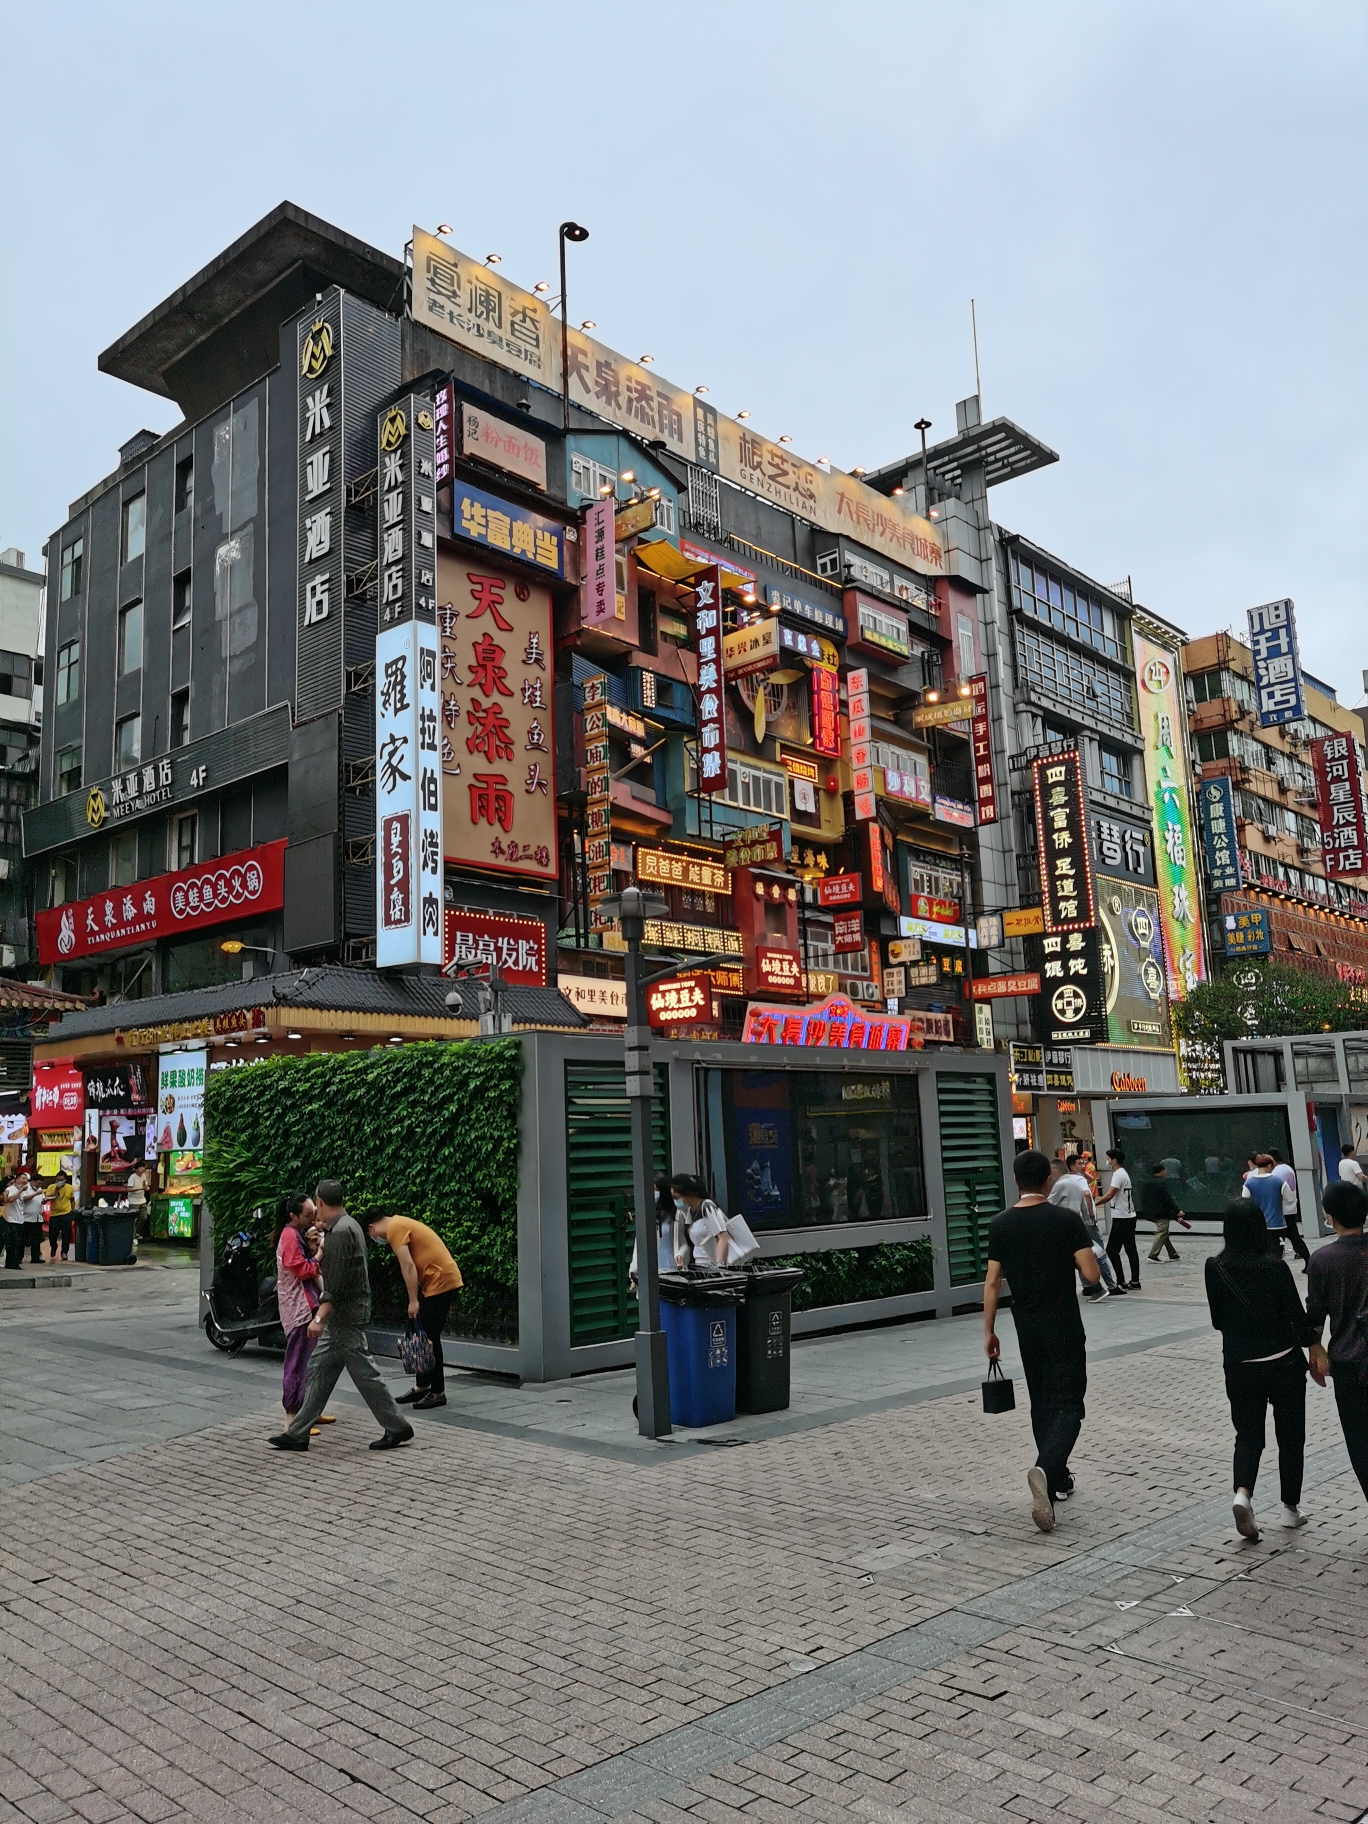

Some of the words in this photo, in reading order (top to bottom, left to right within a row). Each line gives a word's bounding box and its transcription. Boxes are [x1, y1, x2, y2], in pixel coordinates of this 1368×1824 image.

[426, 251, 540, 346] 宴澜香
[427, 297, 541, 370] 老长沙臭豆腐
[560, 342, 683, 444] 天泉添雨
[466, 414, 479, 441] 杨记
[481, 423, 543, 468] 粉面饭
[304, 383, 332, 627] 米亚酒店
[740, 469, 816, 517] GENZHILIAN
[382, 449, 402, 606] 米亚酒店
[419, 459, 433, 586] 米亚酒店
[461, 498, 558, 561] 华富典当
[594, 508, 605, 617] 汇源糕点专卖
[383, 601, 402, 622] 4F
[419, 596, 434, 610] 4F
[726, 632, 773, 659] 华兴冰室
[1252, 601, 1297, 716] 旭升酒店
[696, 580, 721, 779] 文和里美食市集
[466, 572, 515, 833] 天泉添雨
[523, 631, 548, 796] 美蛙鱼头
[972, 681, 995, 820] 鸿运手工粉面馆
[111, 759, 173, 805] 米亚酒店
[190, 765, 207, 788] 4F
[420, 646, 439, 937] 阿拉伯烤肉
[113, 800, 140, 819] MEEYA
[144, 788, 172, 807] HOTEL
[1324, 737, 1362, 871] 银河星辰酒店
[1045, 765, 1078, 919] 四喜富侨足道馆
[1091, 819, 1145, 876] 琴行
[1157, 712, 1198, 991] 周六福珠宝
[174, 867, 259, 912] 美蛙鱼头火锅
[389, 820, 405, 922] 臭豆腐
[824, 882, 855, 895] 仙境豆夫
[86, 891, 156, 933] 天泉添雨
[87, 919, 157, 945] TIANQUANTIANYU
[835, 918, 860, 934] 南洋
[1138, 919, 1148, 934] 四
[1238, 913, 1263, 929] 美甲
[455, 931, 538, 972] 最高发院
[835, 933, 861, 944] 大师傅
[1043, 933, 1086, 953] 四喜
[659, 983, 680, 992] SHINING
[681, 980, 695, 988] TOFU
[761, 959, 800, 977] 仙境豆夫
[1045, 958, 1088, 979] 馄饨
[1147, 967, 1159, 988] 喜
[650, 987, 705, 1010] 仙境豆夫
[161, 1067, 203, 1090] 鲜果酸奶捞
[1111, 1070, 1147, 1092] Cabbeen
